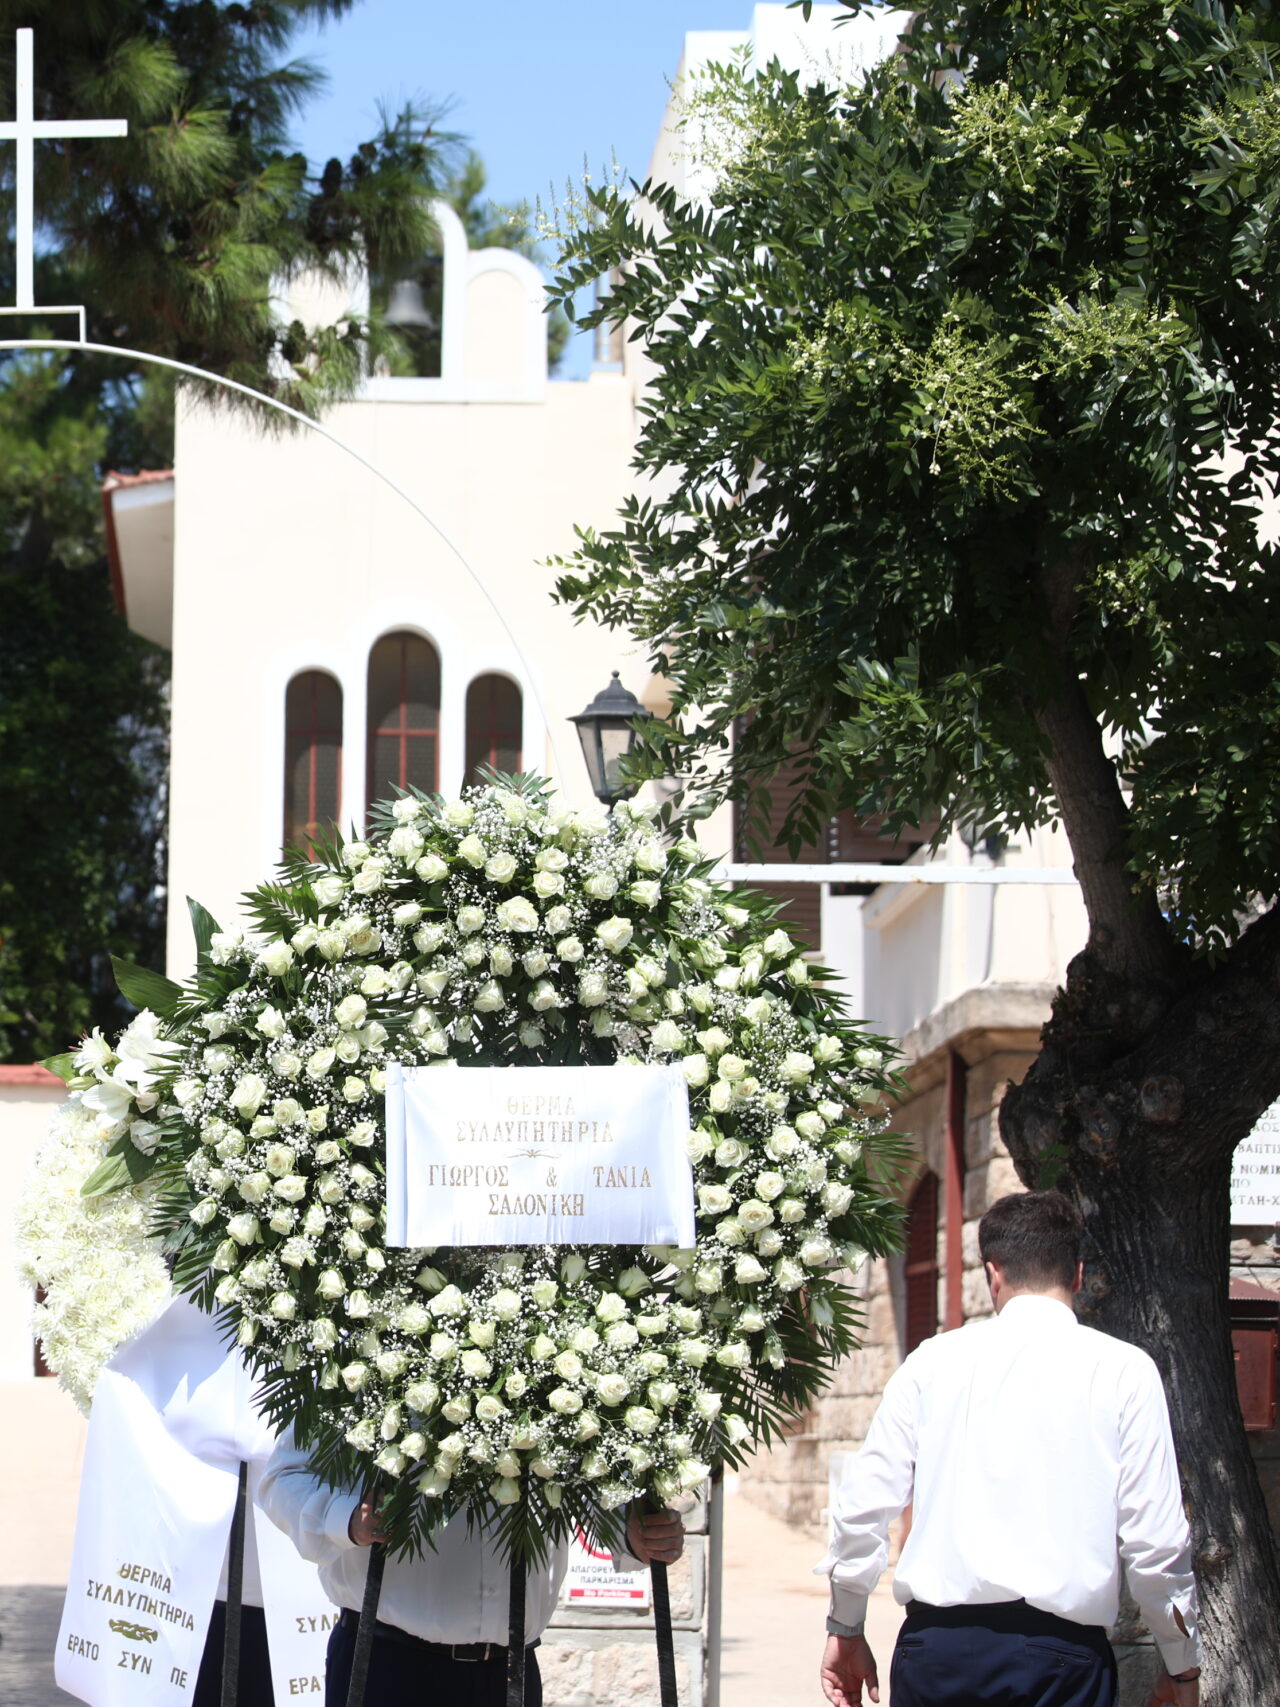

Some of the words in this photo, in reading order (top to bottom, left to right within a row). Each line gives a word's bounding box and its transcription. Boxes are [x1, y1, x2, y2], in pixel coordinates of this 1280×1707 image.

[506, 1095, 576, 1116] ΘΕΡΜΑ
[456, 1121, 614, 1143] ΣΥΛΛΥΠΗΤΗΡΙΑ
[428, 1164, 509, 1187] ΓΙΩΡΓΟΣ
[546, 1166, 558, 1188] &
[592, 1165, 652, 1188] ΤΑΝΙΑ
[1231, 1178, 1250, 1188] ΠΟ
[488, 1193, 585, 1217] ΣΑΛΟΝΙΚΗ
[118, 1562, 172, 1594] ΘΕΡΜΑ
[581, 1575, 634, 1584] ΠΑΡΚΑΡΙΣΜΑ
[86, 1579, 195, 1632] ΣΥΛΛΥΠΗΤΗΡΙΑ
[67, 1634, 100, 1661] ΕΡΑΤΟ
[117, 1650, 152, 1675] ΣΥΝ
[289, 1674, 326, 1695] ΕΡΑ
